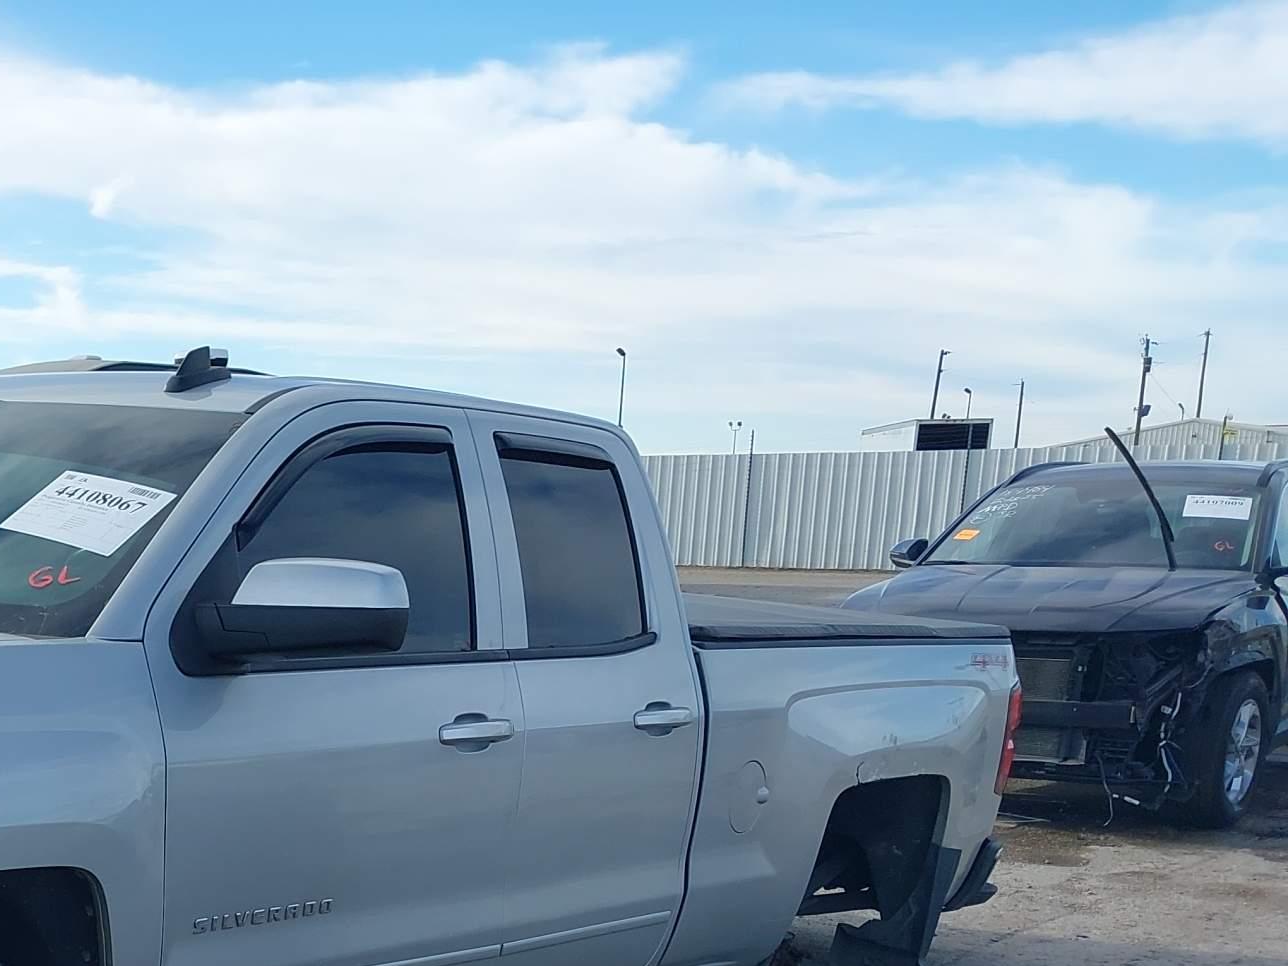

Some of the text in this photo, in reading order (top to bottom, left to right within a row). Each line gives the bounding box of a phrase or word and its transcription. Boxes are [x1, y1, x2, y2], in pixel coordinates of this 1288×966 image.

[54, 484, 149, 514] 44108067
[28, 564, 81, 588] GL
[192, 898, 334, 935] SILVERADO
